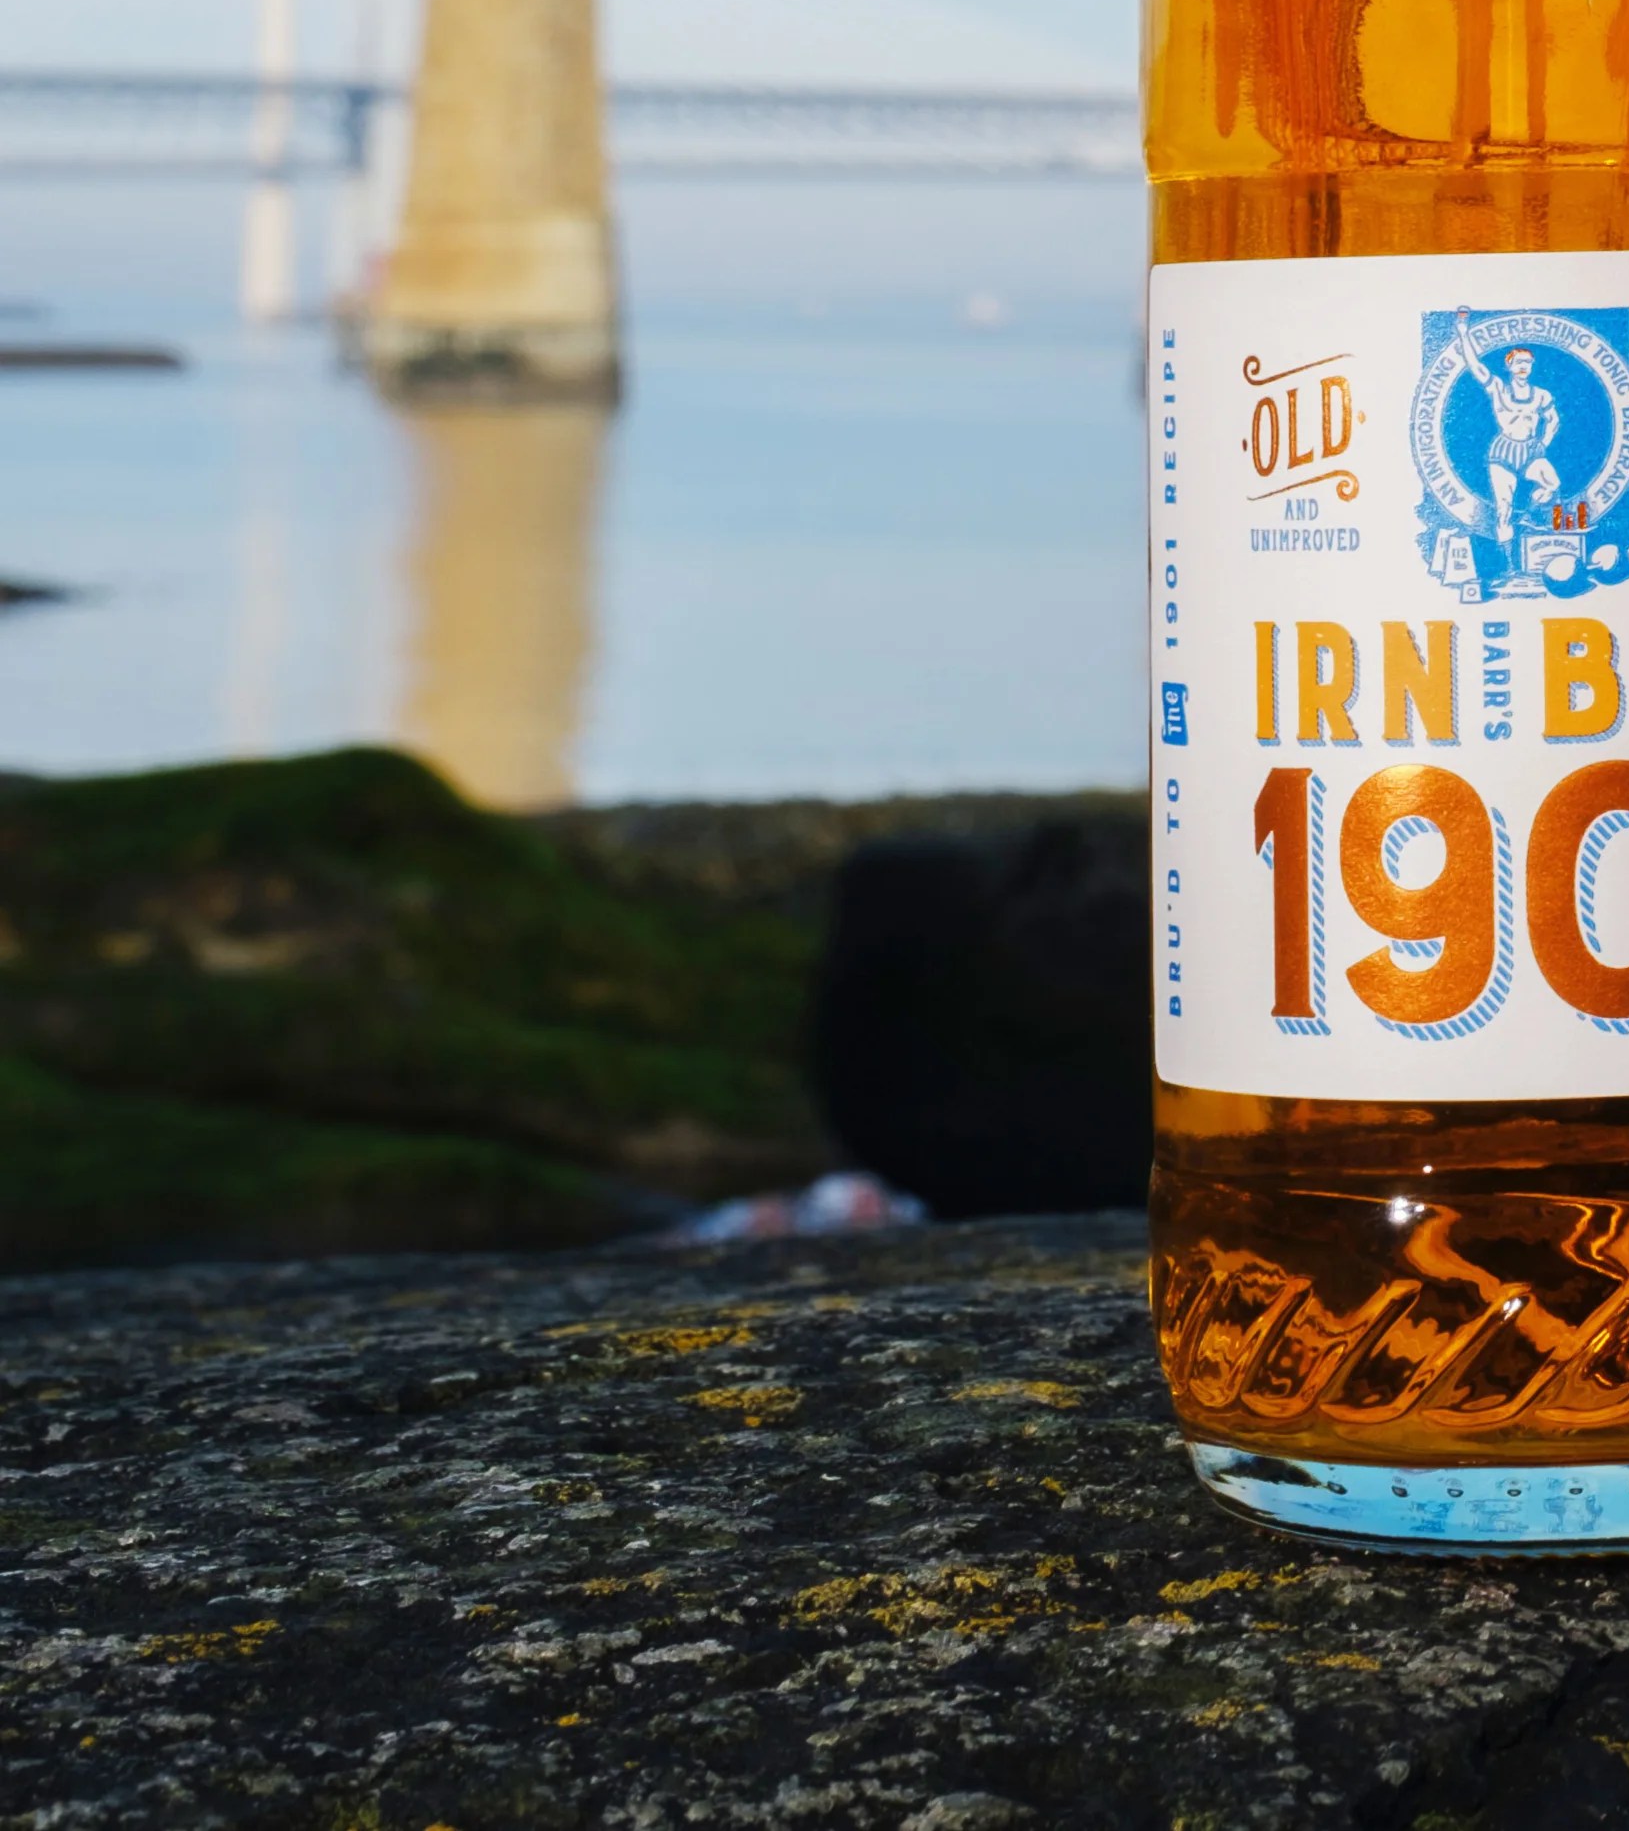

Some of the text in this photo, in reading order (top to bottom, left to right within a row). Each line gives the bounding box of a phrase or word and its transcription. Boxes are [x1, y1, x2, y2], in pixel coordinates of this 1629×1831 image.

[1471, 316, 1593, 351] REFRESHING
[1162, 327, 1177, 505] RECIPE
[1251, 375, 1353, 477] OLD
[1417, 356, 1457, 482] INVIGORATING
[1249, 527, 1361, 553] UNIMPROVED
[1284, 498, 1319, 522] AND
[1439, 481, 1466, 507] AN
[1165, 538, 1178, 649] 1901
[1253, 620, 1461, 747] IRN
[1482, 620, 1511, 741] BARR'S
[1167, 778, 1180, 835] TO
[1168, 868, 1183, 1018] BRU'D
